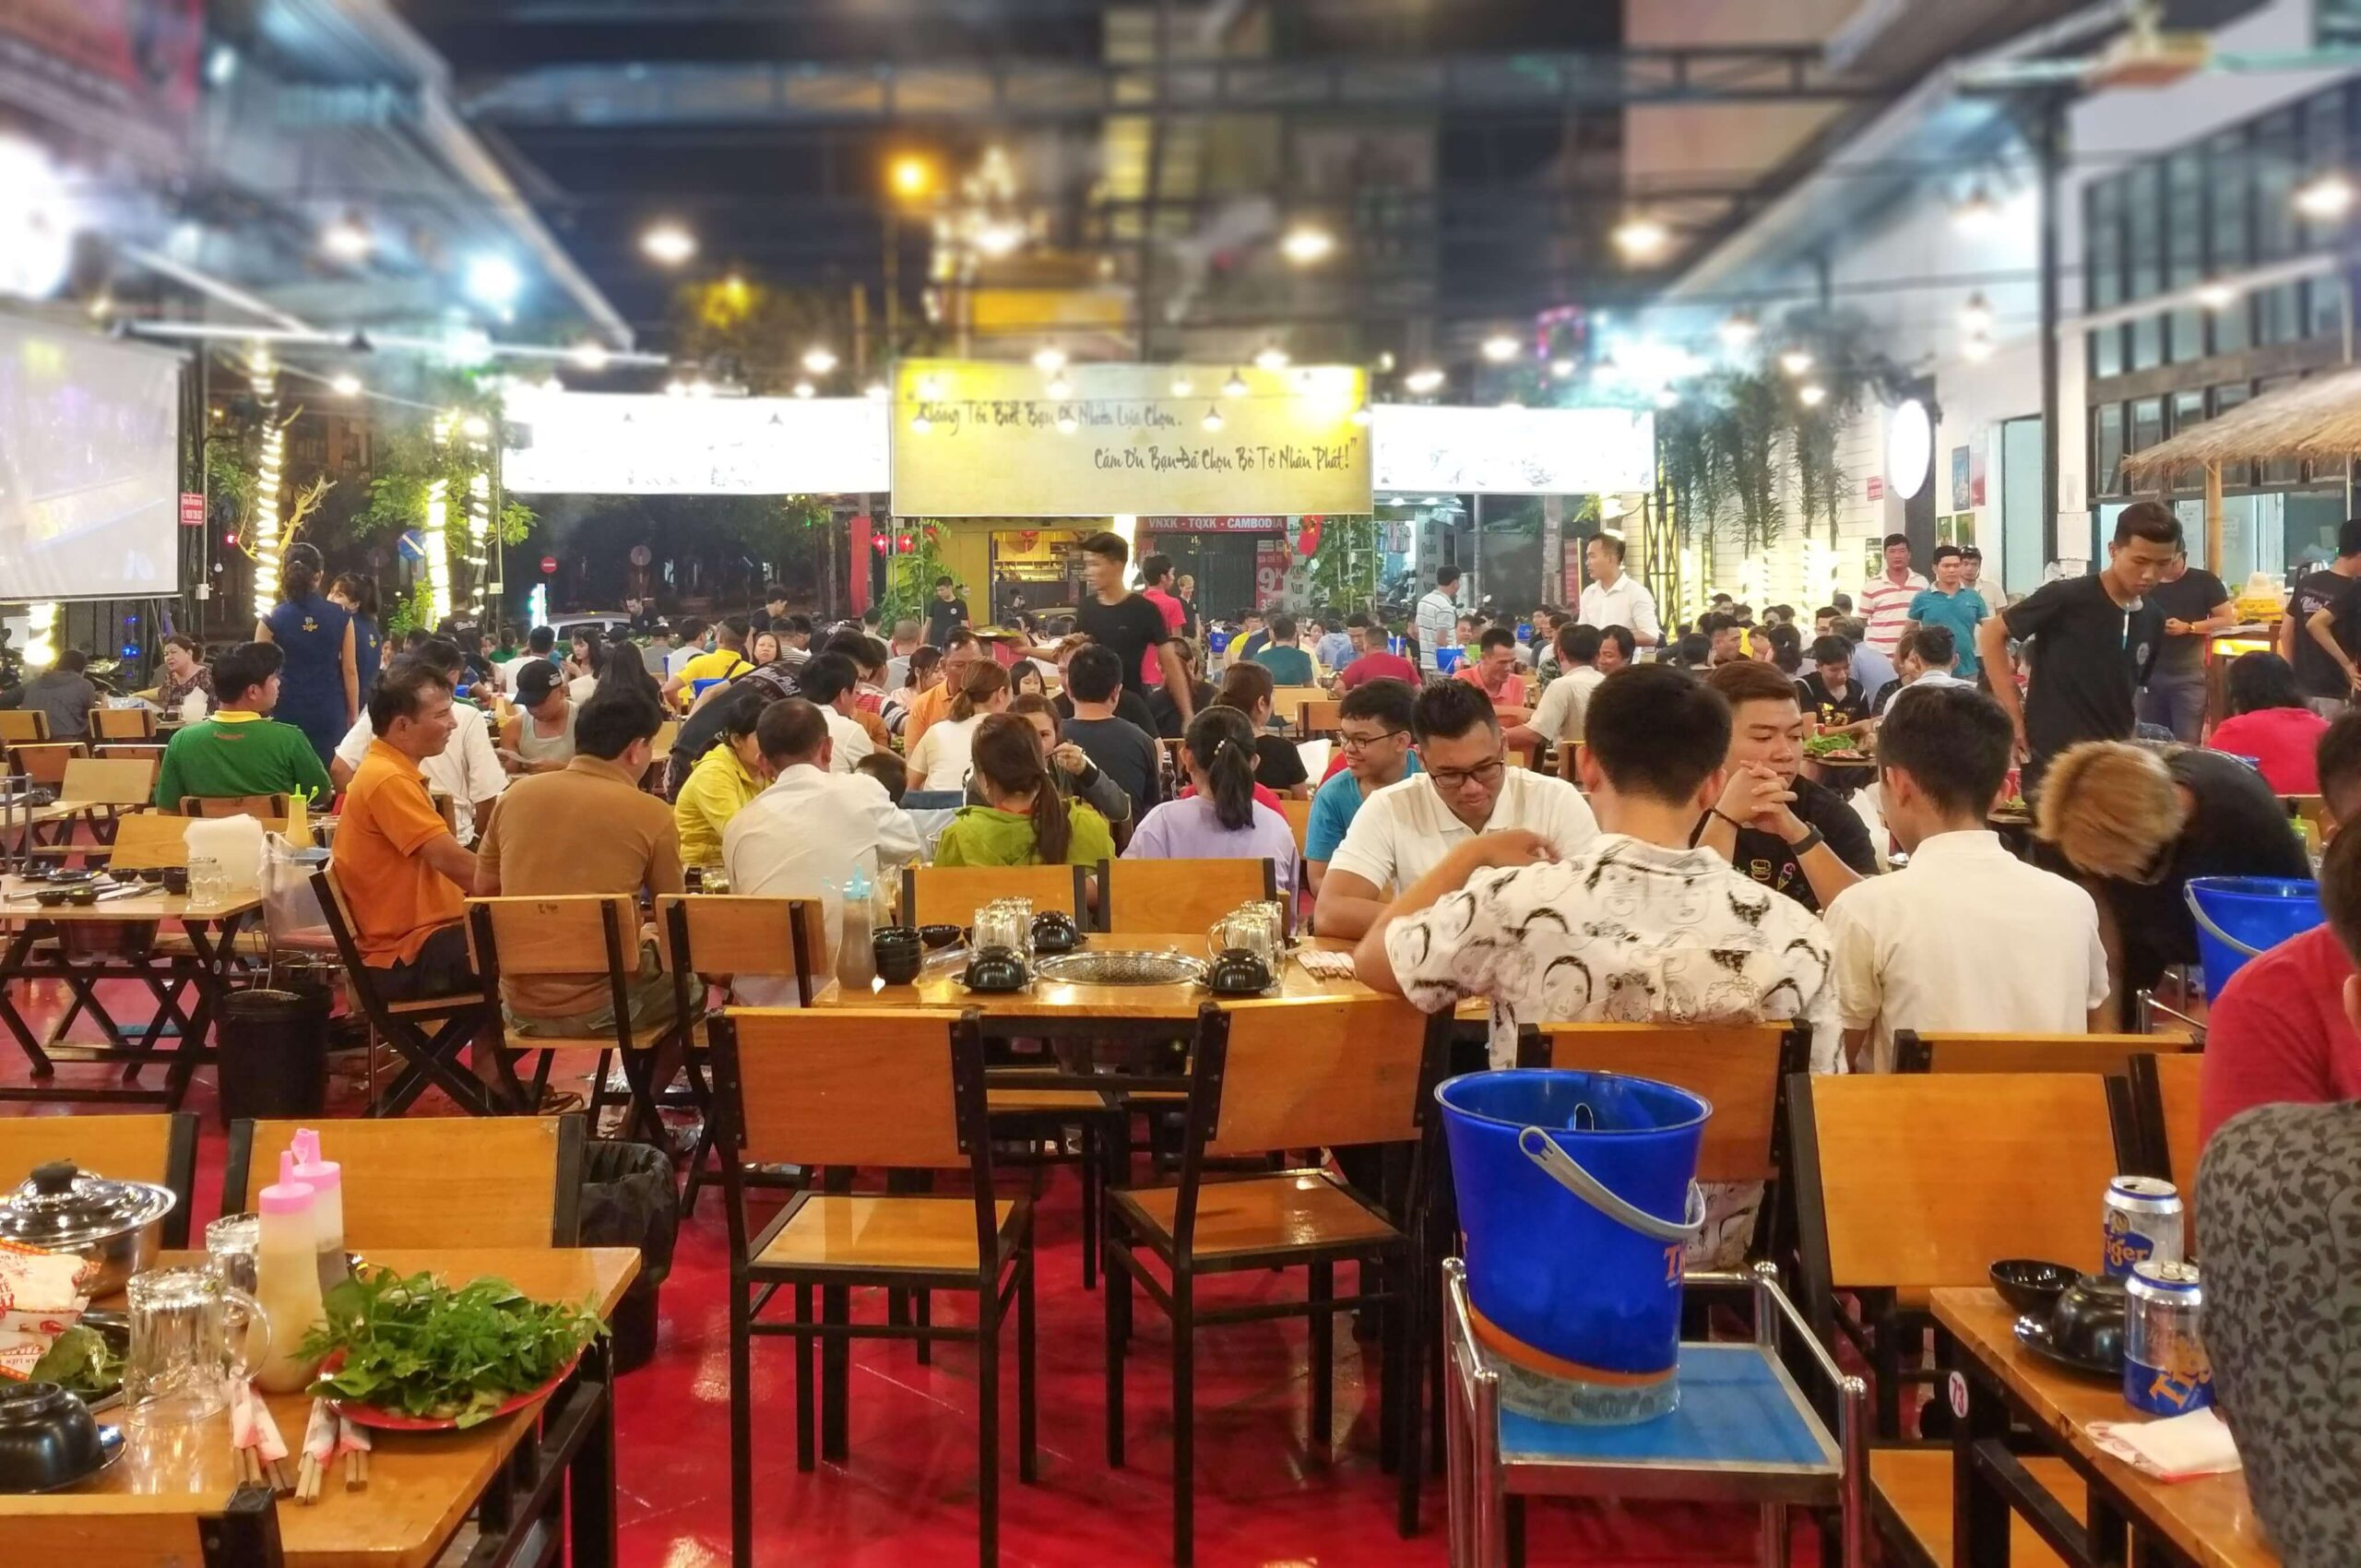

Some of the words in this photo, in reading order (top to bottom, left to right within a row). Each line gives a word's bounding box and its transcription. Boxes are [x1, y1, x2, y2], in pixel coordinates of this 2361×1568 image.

[1094, 446, 1122, 469] Cám
[1202, 445, 1233, 473] Chọn
[1148, 517, 1178, 529] VNXK
[1188, 517, 1217, 529] TQXK
[1227, 517, 1283, 529] CAMBODIA
